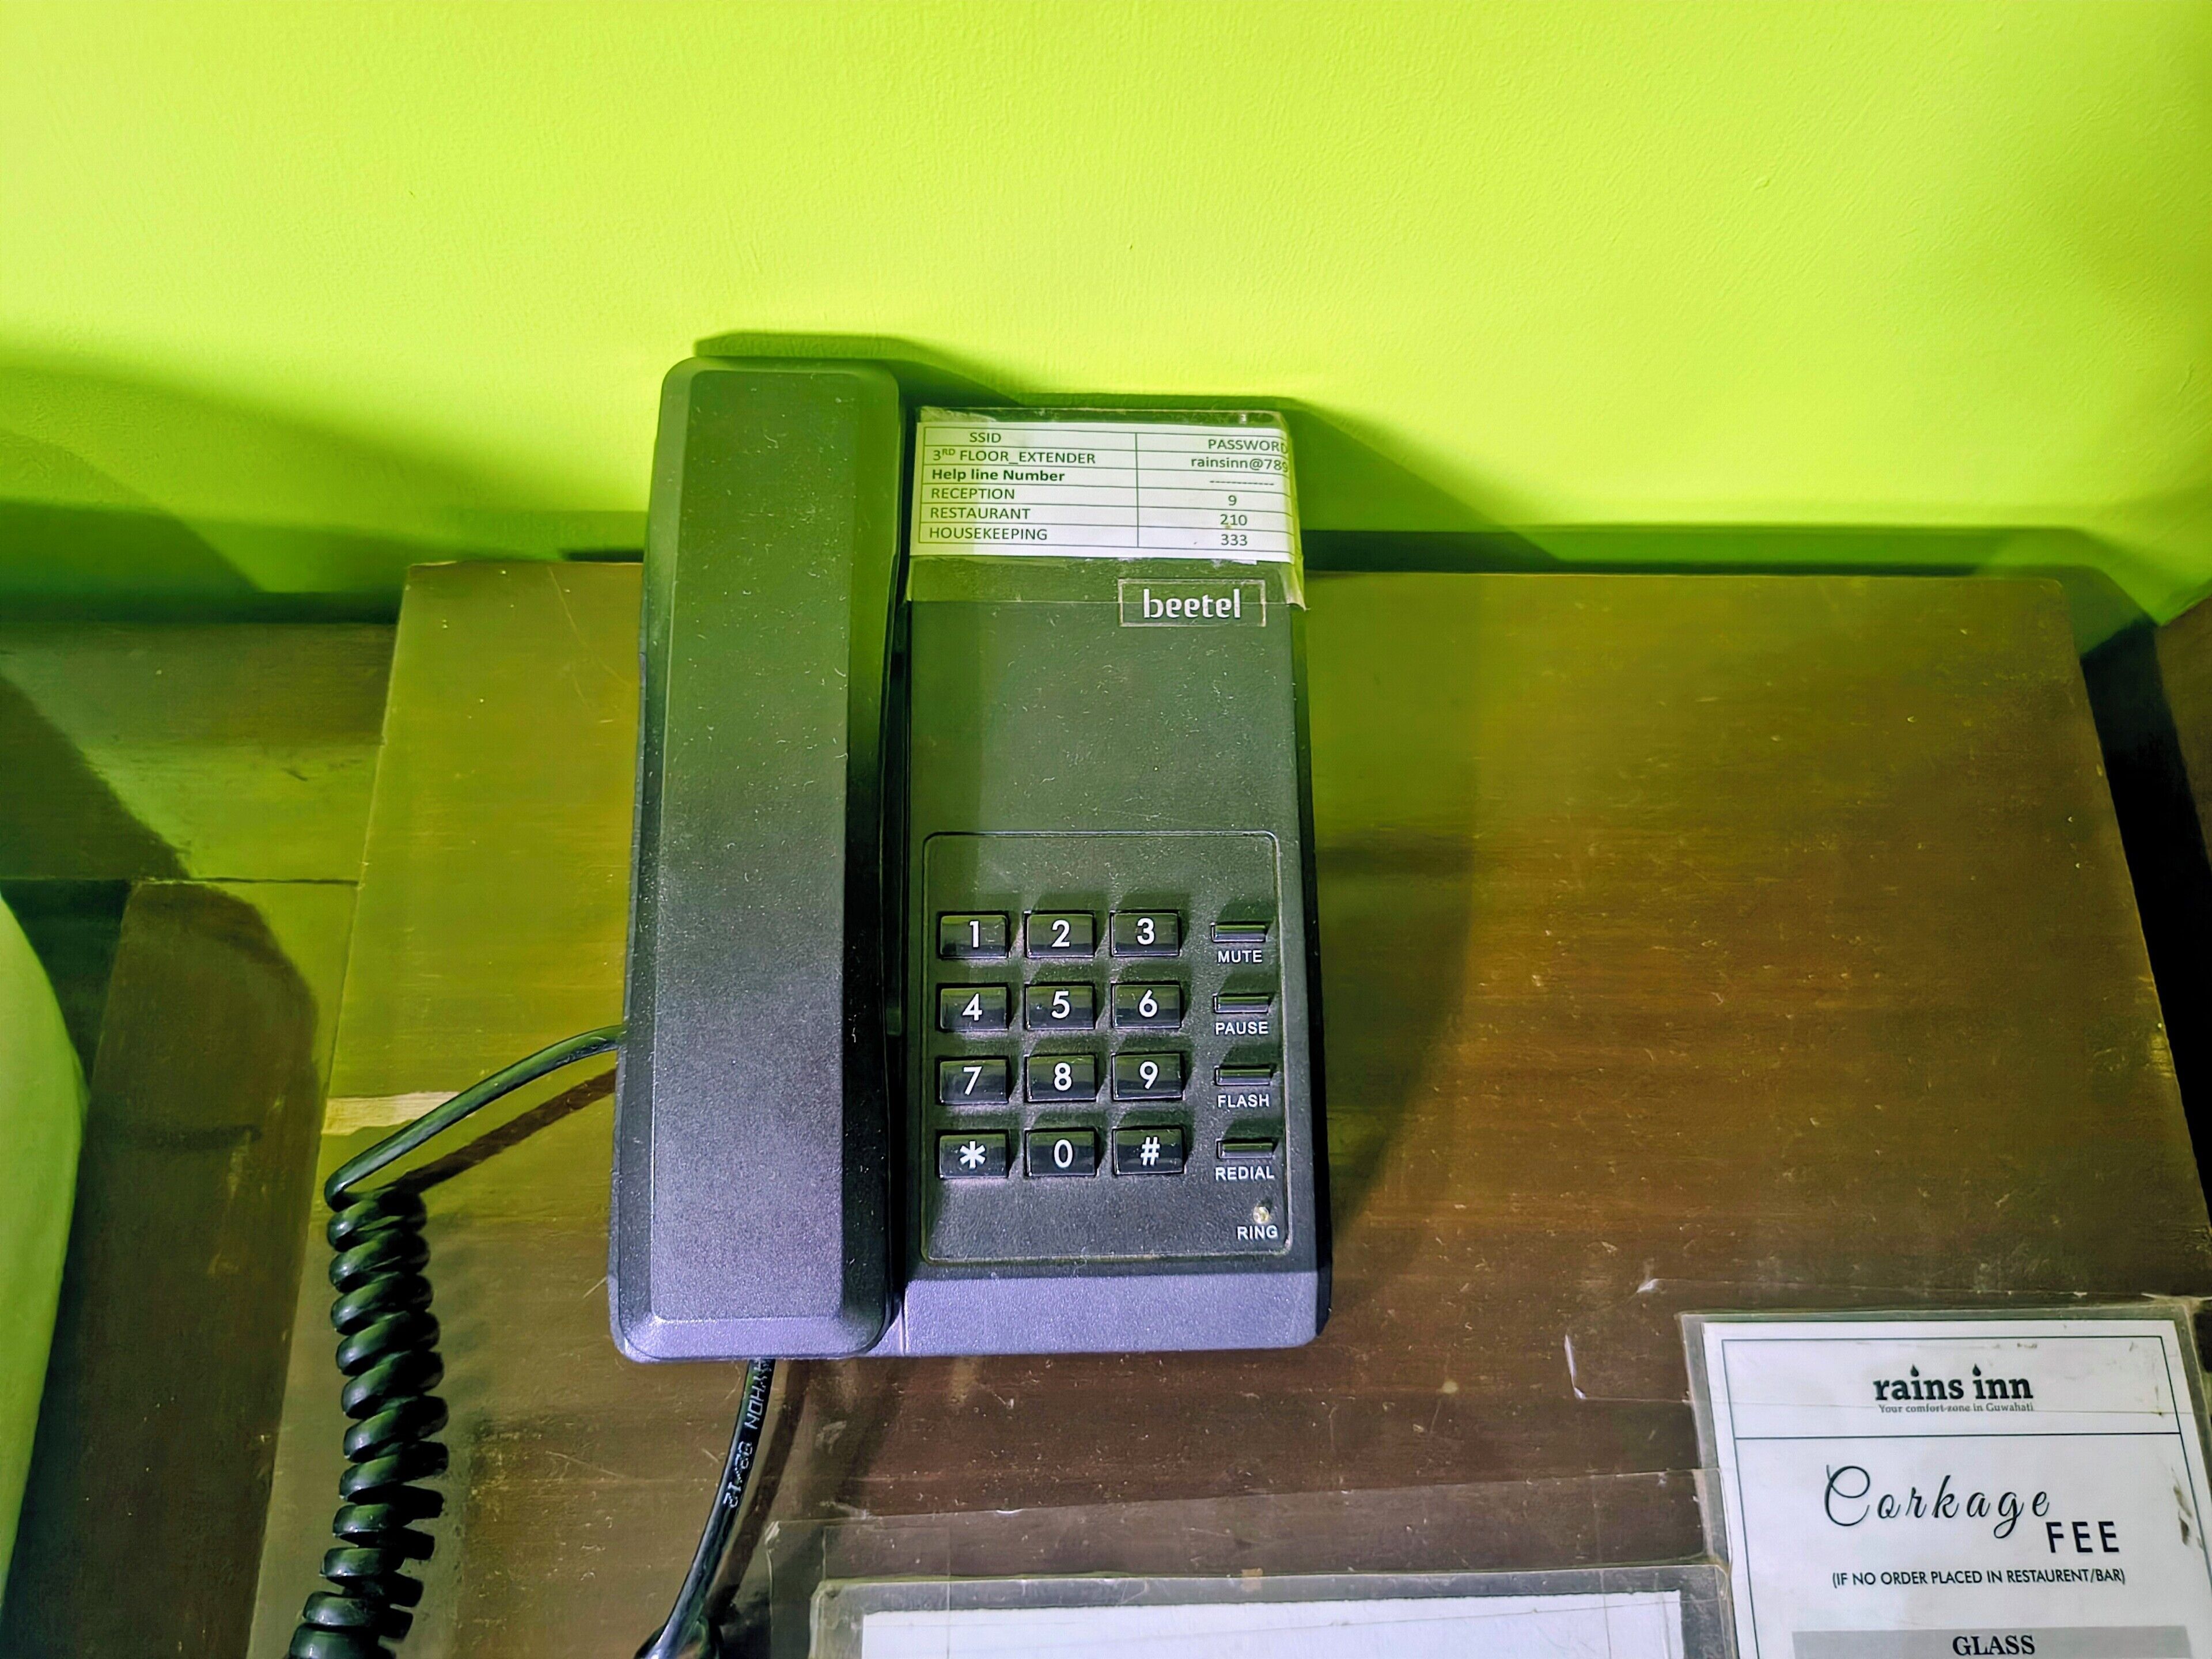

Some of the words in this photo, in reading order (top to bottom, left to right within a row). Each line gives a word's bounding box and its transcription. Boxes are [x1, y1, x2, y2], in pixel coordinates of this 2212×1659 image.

[969, 432, 1001, 443] SSID
[1209, 440, 1288, 454] PASSWORD
[933, 449, 955, 461] 3RD
[960, 450, 1096, 464] FLOOR_EXTENDER
[933, 469, 966, 481] Help
[971, 469, 998, 480] line
[1003, 470, 1065, 482] Number
[931, 488, 1015, 499] RECEPTION
[1229, 495, 1237, 505] 9
[931, 507, 1031, 520] RESTAURANT
[1221, 514, 1247, 527] 210
[930, 527, 1047, 540] HOUSEKEEPING
[1222, 534, 1248, 547] 333
[1143, 589, 1241, 619] beetel
[969, 921, 979, 948] 1
[1052, 920, 1070, 948] 2
[1137, 918, 1154, 946] 3
[1218, 950, 1263, 963] MUTE
[963, 993, 982, 1021] 4
[1051, 991, 1070, 1019] 5
[1139, 990, 1157, 1018] 6
[1216, 1022, 1268, 1035] PAUSE
[963, 1066, 982, 1095] 7
[1053, 1063, 1072, 1091] 8
[1139, 1061, 1158, 1090] 9
[1218, 1094, 1270, 1108] FLASH
[1054, 1139, 1073, 1168] 0
[1141, 1137, 1160, 1166] #
[1215, 1166, 1275, 1181] REDIAL
[1237, 1226, 1278, 1240] RING
[1873, 1365, 1964, 1400] rains
[1972, 1363, 2033, 1399] inn
[1879, 1404, 1902, 1413] Your
[1974, 1403, 1983, 1411] in
[1986, 1402, 2033, 1412] Guwahati
[1824, 1464, 2050, 1539] Corkage
[2046, 1521, 2120, 1554] FEE
[1832, 1573, 1849, 1589] (IF
[1852, 1573, 1876, 1585] NO
[1881, 1572, 1928, 1585] ORDER
[1931, 1570, 1982, 1584] PLACED
[1987, 1570, 2003, 1583] IN
[2007, 1569, 2126, 1585] RESTAURENT/BAR)
[1952, 1635, 2036, 1656] GLASS
